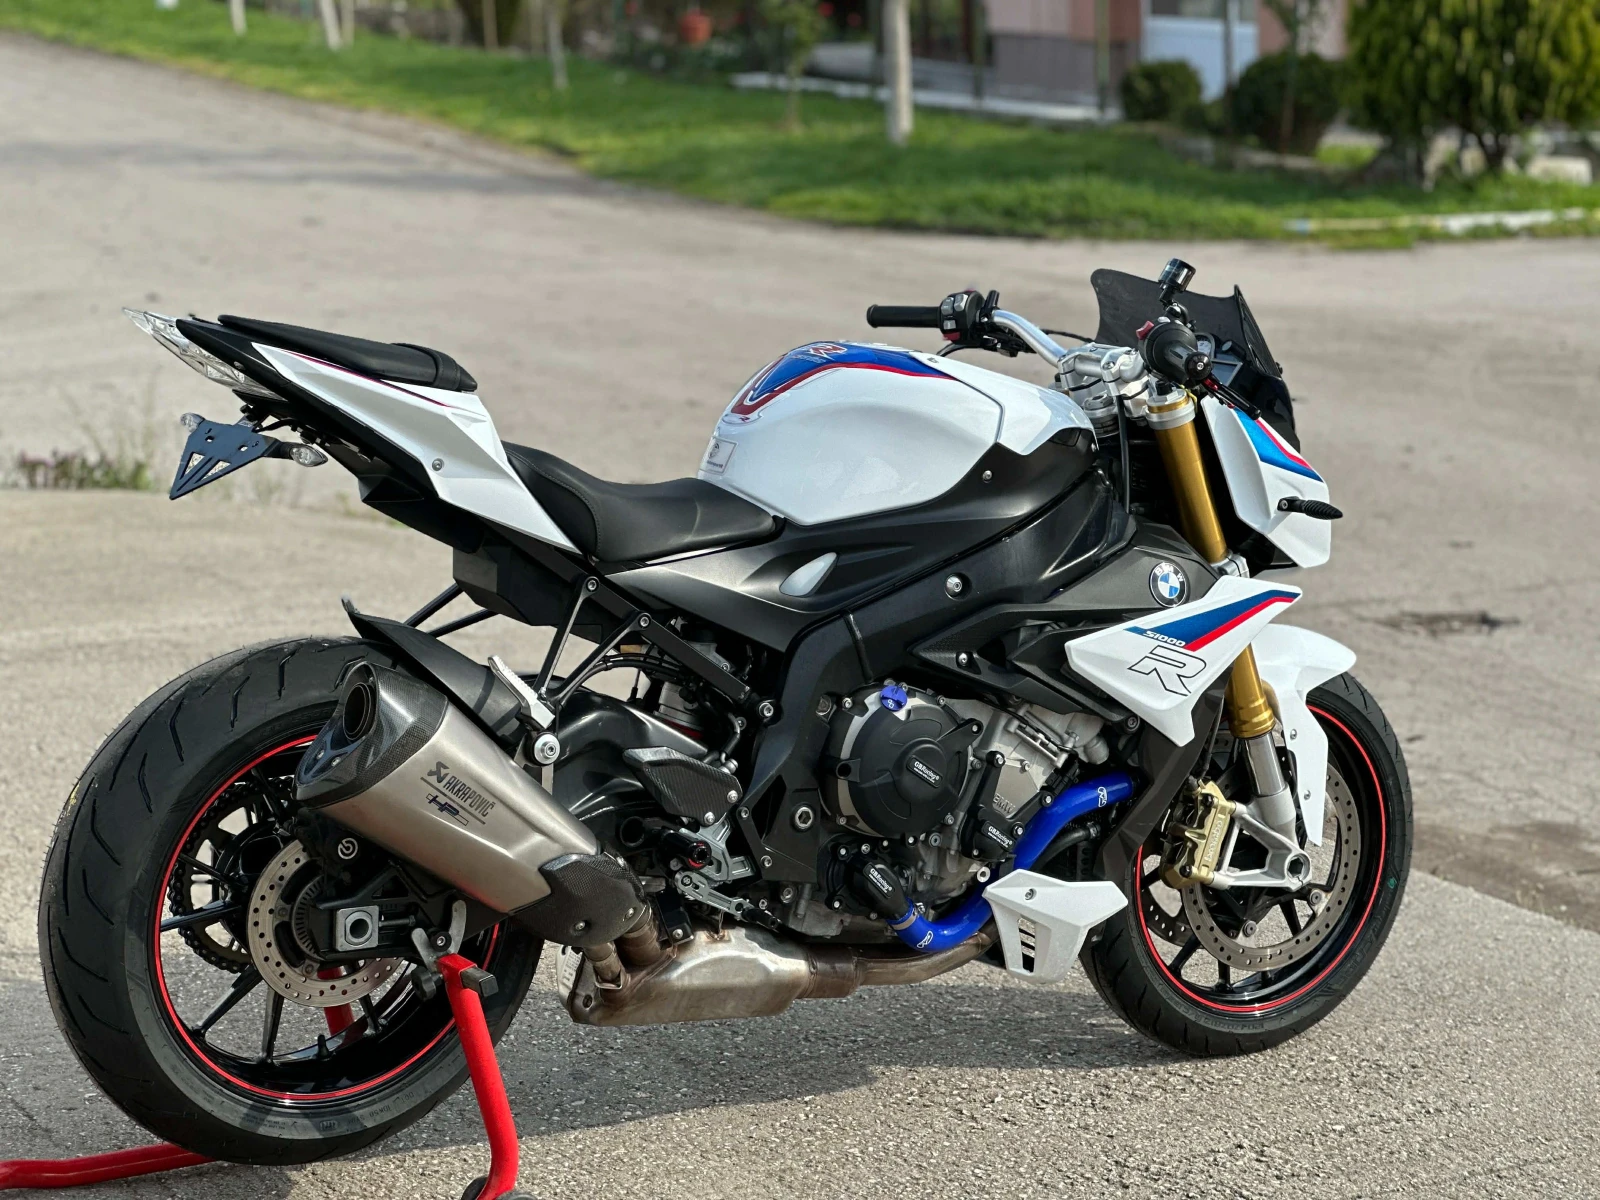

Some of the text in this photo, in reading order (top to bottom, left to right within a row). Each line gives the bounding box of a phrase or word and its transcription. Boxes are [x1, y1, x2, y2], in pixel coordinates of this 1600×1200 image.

[1154, 562, 1184, 582] BMW
[1143, 630, 1186, 647] S1000
[1127, 645, 1207, 697] R
